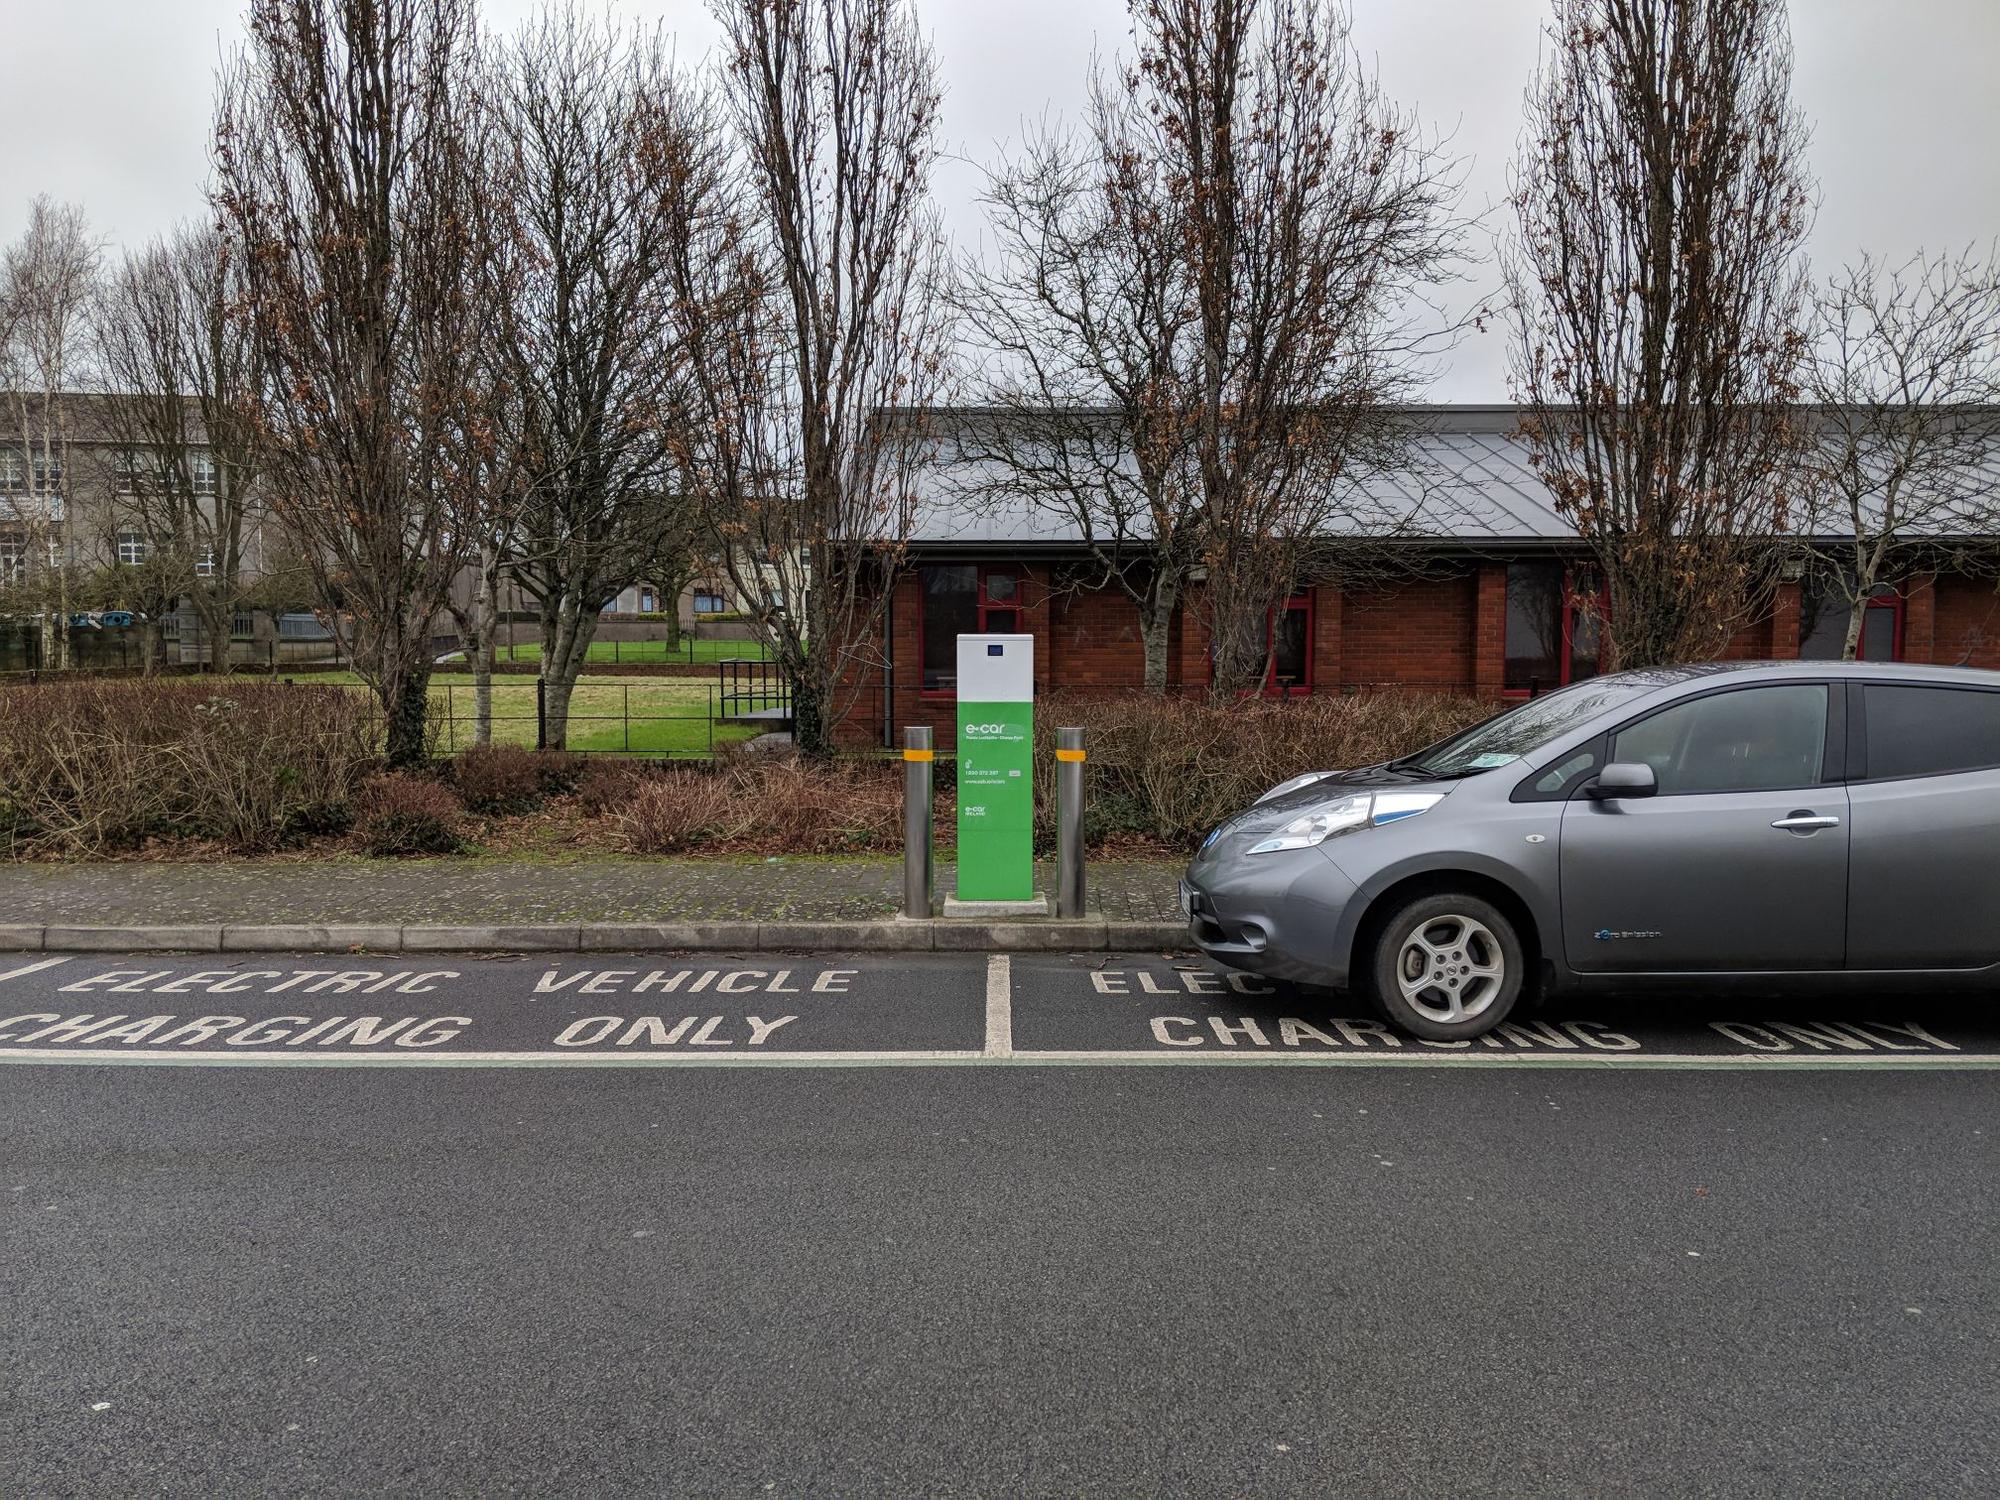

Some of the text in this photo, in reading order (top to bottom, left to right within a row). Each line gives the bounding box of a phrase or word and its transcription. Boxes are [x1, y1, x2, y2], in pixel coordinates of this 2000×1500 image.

[57, 970, 859, 993] ELECTRIC VEHICLE
[1089, 971, 1277, 995] ELEC
[0, 1013, 799, 1047] CHARGING ONLY
[1149, 1016, 1961, 1051] CHARNG ONLY
